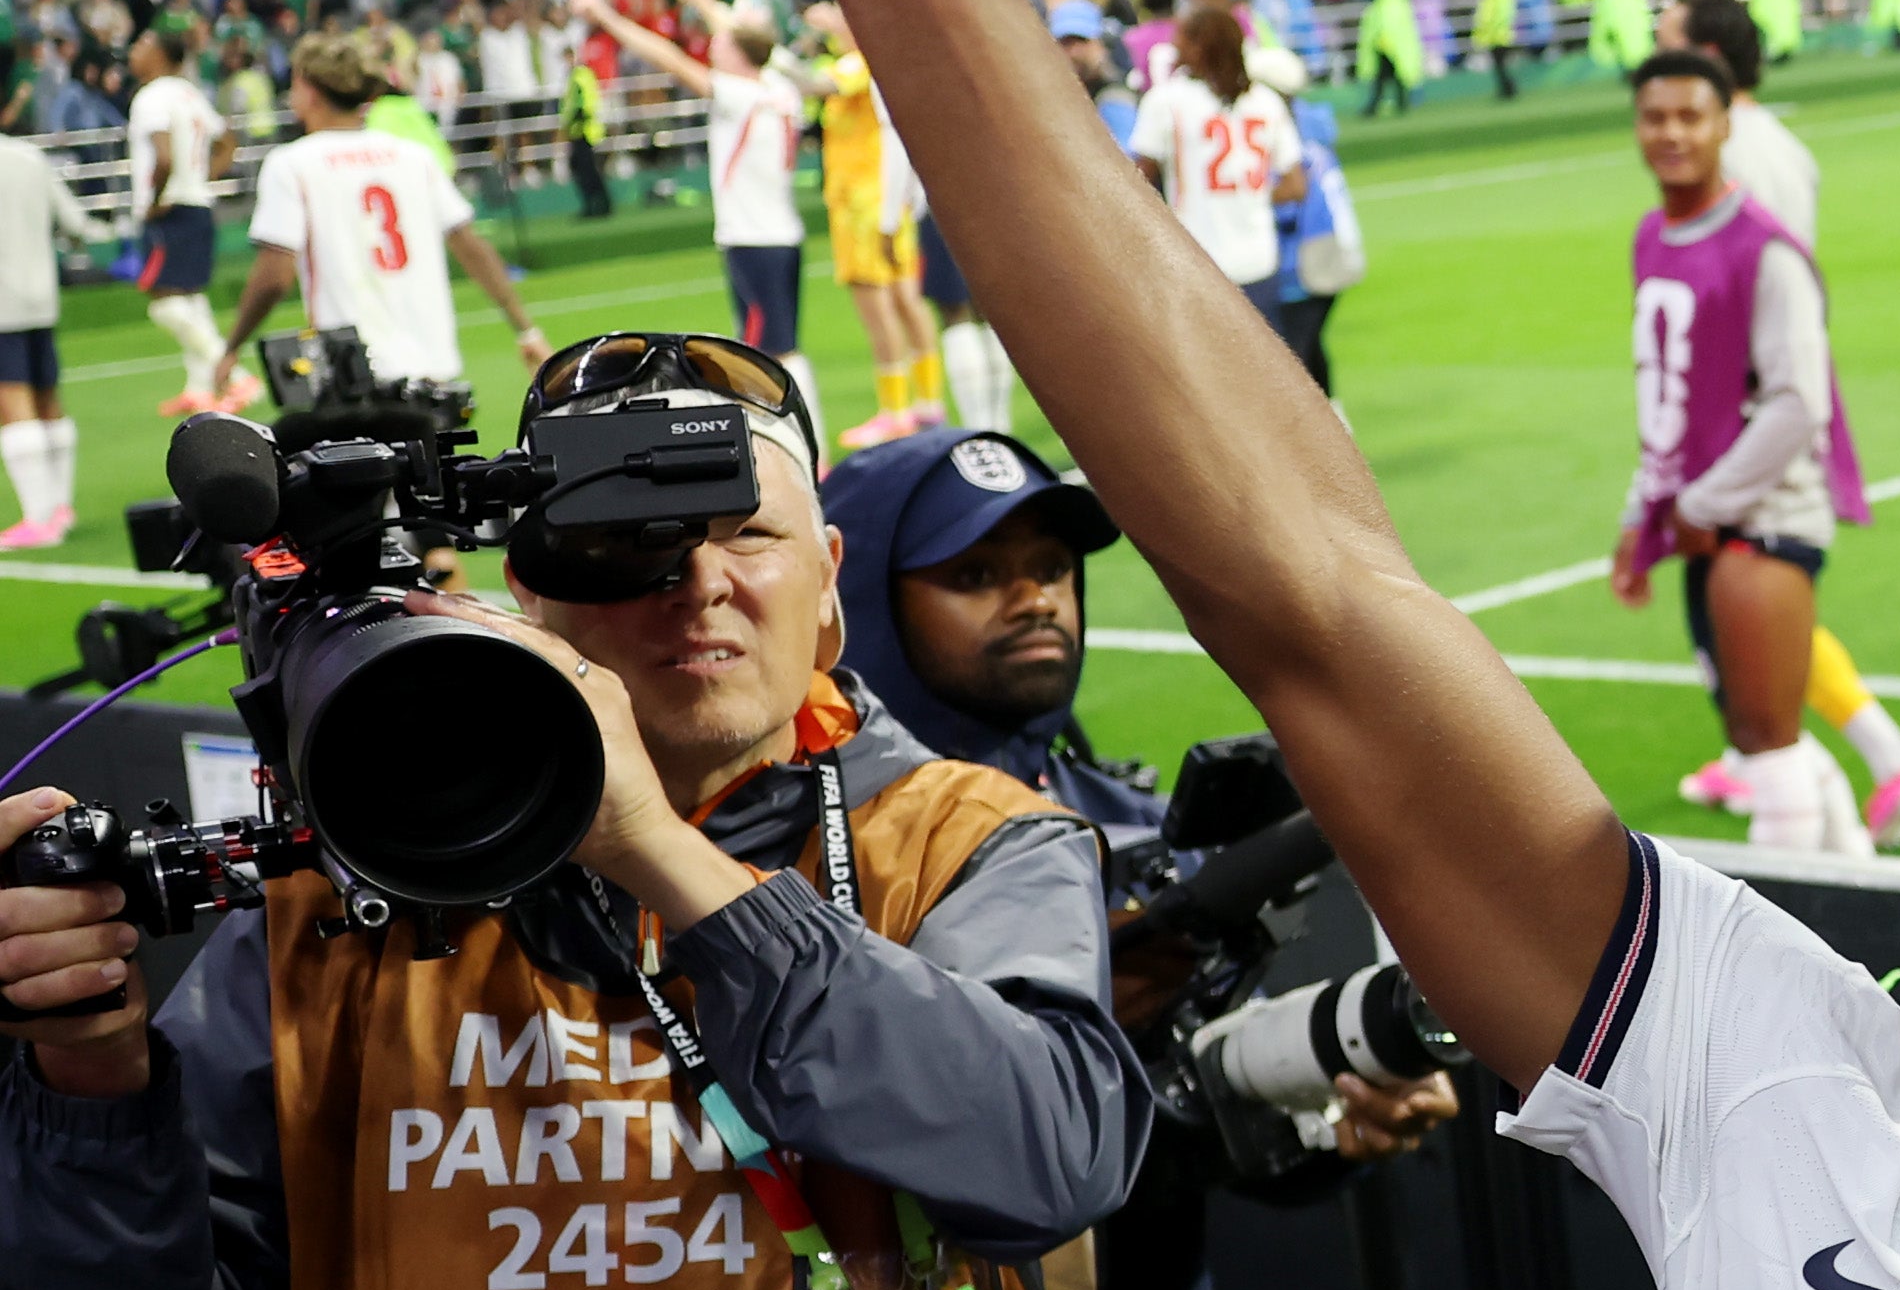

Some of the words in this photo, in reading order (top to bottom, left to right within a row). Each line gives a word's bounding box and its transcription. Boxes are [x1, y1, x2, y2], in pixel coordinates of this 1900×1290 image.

[1204, 116, 1271, 191] 25
[364, 184, 408, 270] 3
[669, 418, 731, 436] SONY
[819, 764, 841, 806] FIFA
[824, 808, 850, 882] WORLD
[449, 1012, 668, 1089] MED
[666, 1023, 707, 1070] FIFA
[388, 1100, 735, 1193] PARTN
